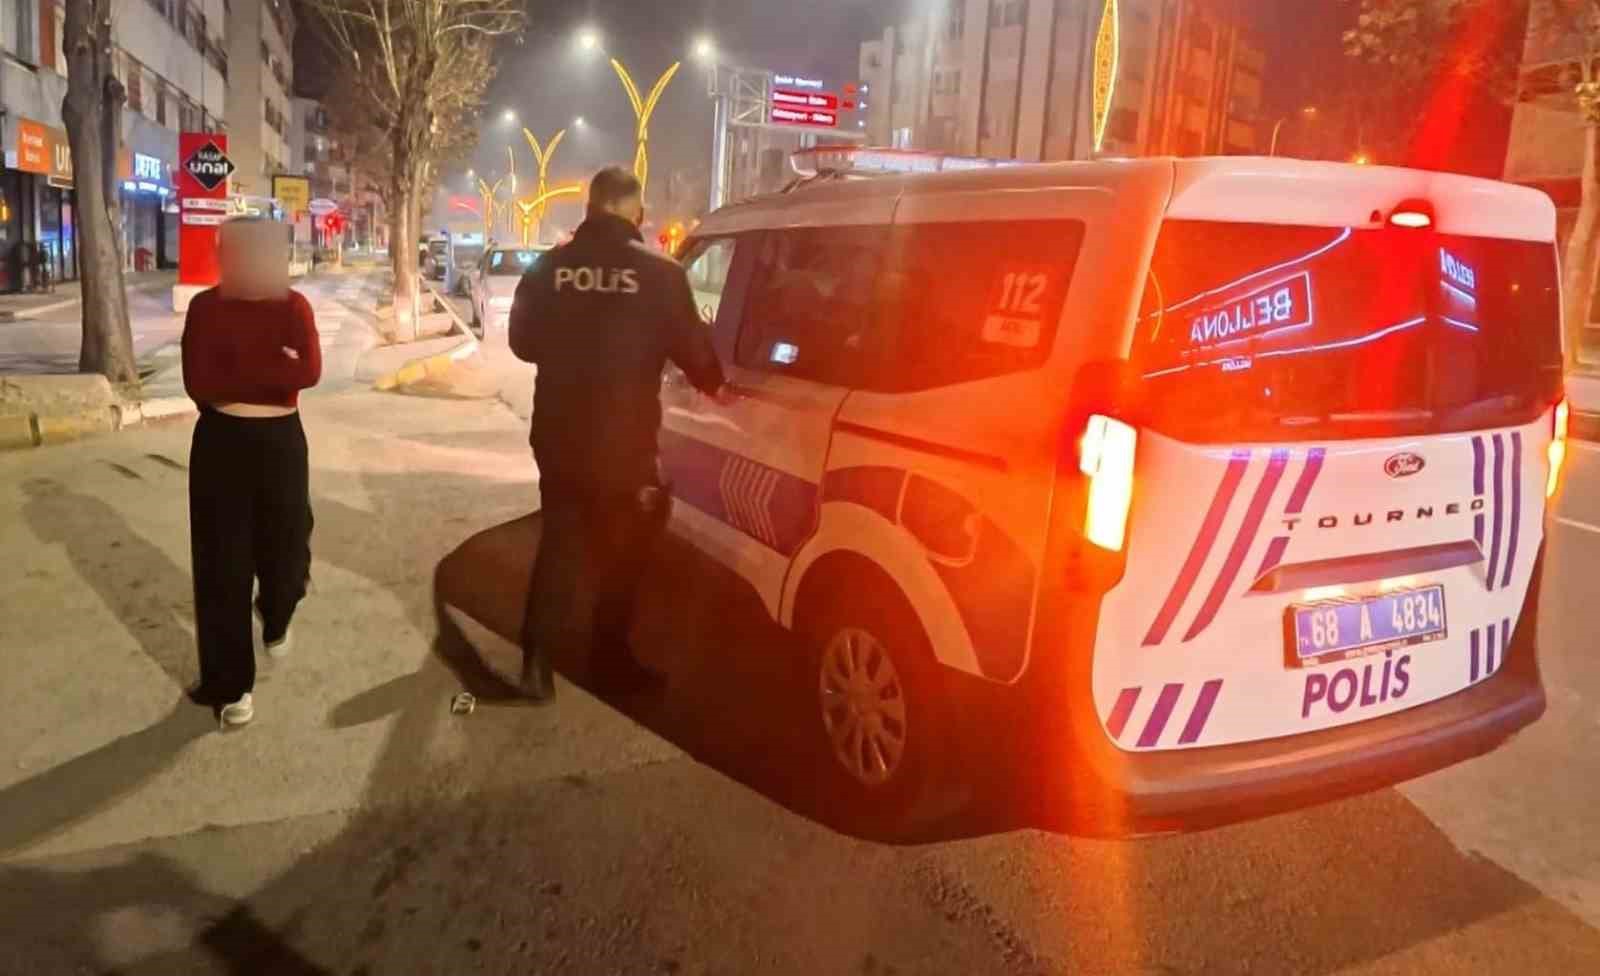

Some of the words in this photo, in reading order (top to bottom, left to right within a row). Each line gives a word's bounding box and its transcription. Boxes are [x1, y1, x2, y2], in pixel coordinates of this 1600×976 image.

[999, 272, 1047, 313] 112
[1282, 498, 1484, 531] TOURNEO
[1311, 608, 1339, 649] 68
[1359, 603, 1373, 641] A
[1391, 591, 1440, 633] 4834
